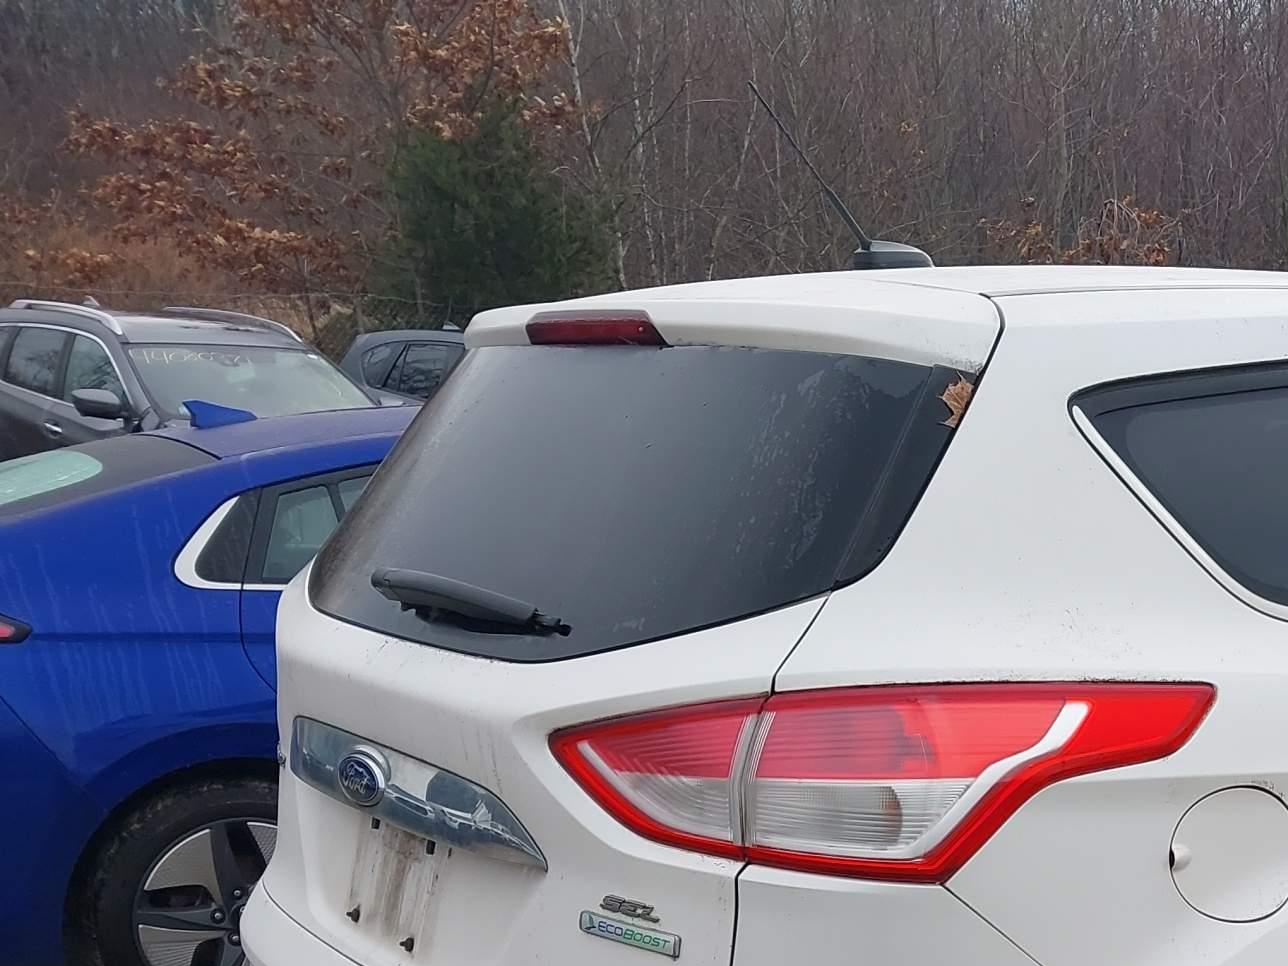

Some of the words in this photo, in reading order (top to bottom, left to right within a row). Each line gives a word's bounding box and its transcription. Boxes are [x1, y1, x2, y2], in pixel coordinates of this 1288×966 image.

[342, 762, 370, 795] Ford
[600, 895, 661, 923] SEL
[598, 920, 671, 949] ECOBOOST
